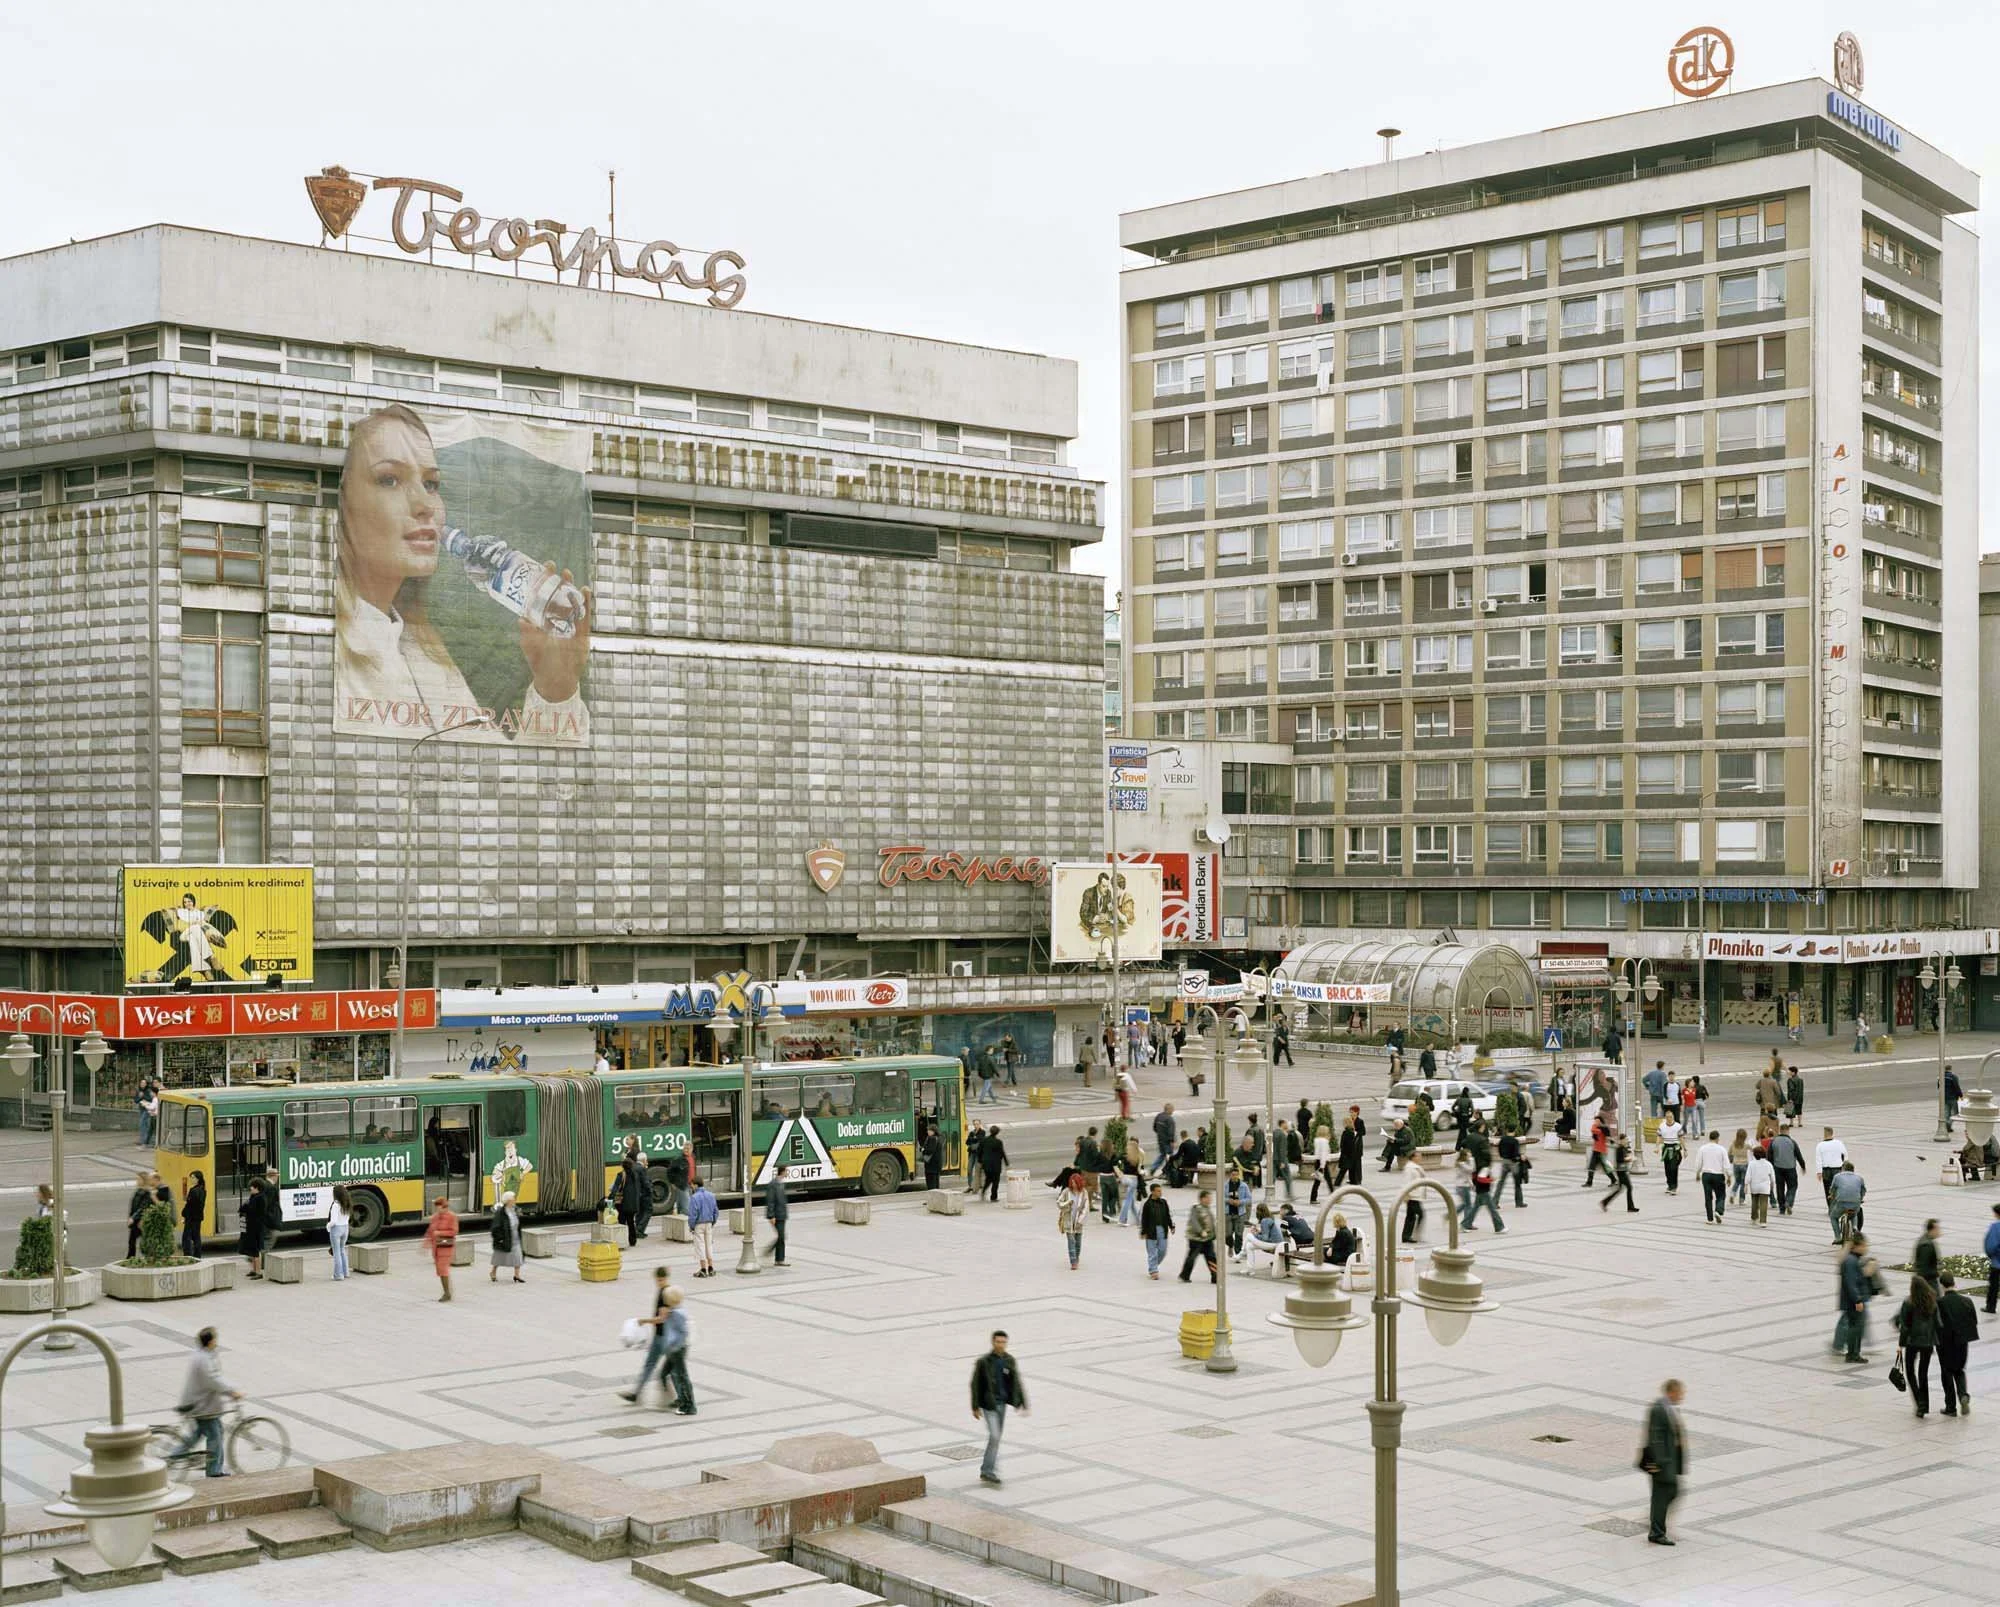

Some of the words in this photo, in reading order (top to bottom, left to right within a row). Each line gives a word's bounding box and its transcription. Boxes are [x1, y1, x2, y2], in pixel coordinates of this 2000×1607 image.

[347, 696, 432, 726] IZVOR
[443, 704, 581, 736] ZDRAVLJA
[1121, 772, 1147, 783] Travel
[1163, 774, 1194, 784] VERDI
[1195, 855, 1206, 887] Bank
[133, 878, 180, 890] Uživajte
[194, 878, 244, 888] udobnim
[247, 878, 305, 888] kreditima!
[1195, 890, 1206, 941] Meridian
[1708, 938, 1765, 957] Planika
[1846, 940, 1870, 958] Planika
[1899, 938, 1921, 955] Planika
[255, 960, 278, 970] 150
[281, 961, 293, 969] m
[664, 969, 763, 1019] MAXI
[864, 985, 899, 1002] Metro
[0, 1002, 31, 1022] West
[134, 1006, 194, 1026] West
[243, 1003, 299, 1022] West
[347, 1000, 399, 1019] West
[491, 1015, 522, 1025] Mesto
[525, 1013, 573, 1024] porodične
[576, 1012, 619, 1023] kupovine
[1464, 1008, 1490, 1017] TRAVL
[1493, 1009, 1524, 1019] AGECY
[470, 1045, 528, 1072] MAXI
[837, 1121, 863, 1138] Dobar
[866, 1118, 905, 1135] domaćin!
[611, 1132, 687, 1154] 51-230
[790, 1134, 805, 1161] E
[289, 1156, 336, 1181] Dobar
[340, 1151, 411, 1177] domaćin!
[772, 1167, 823, 1180] EROLIFT
